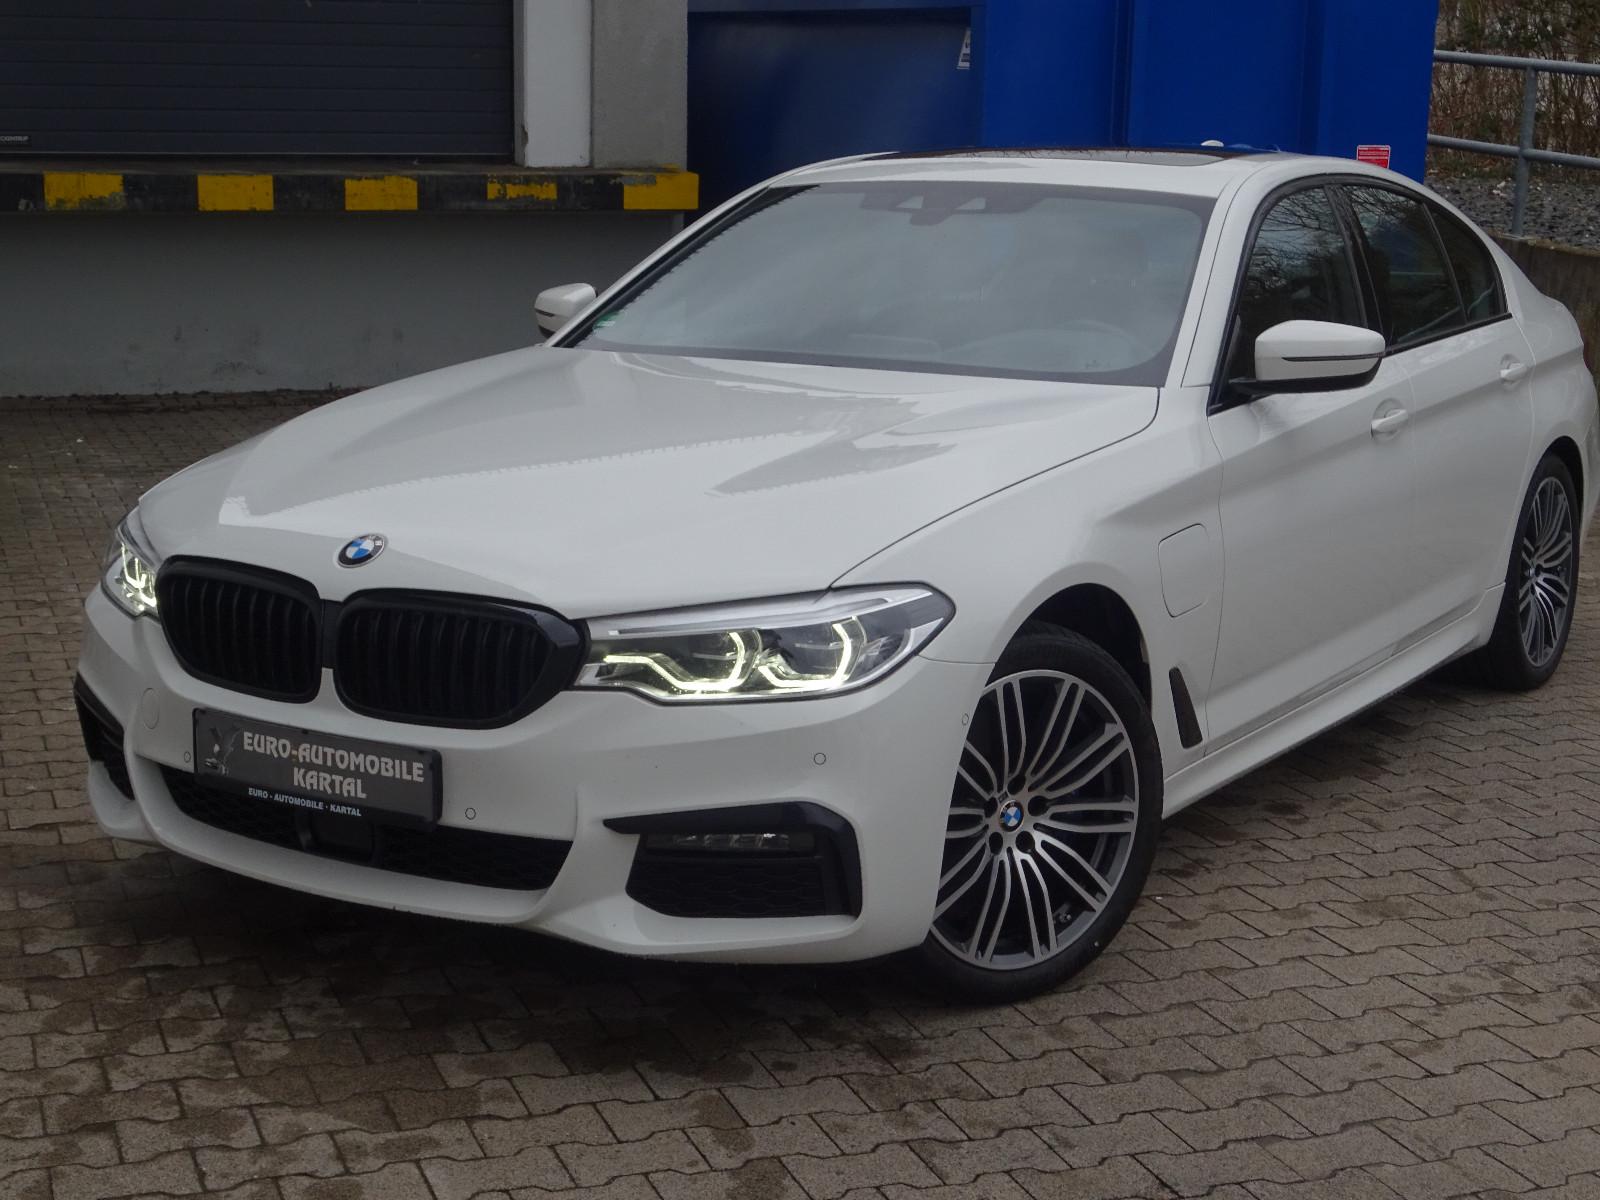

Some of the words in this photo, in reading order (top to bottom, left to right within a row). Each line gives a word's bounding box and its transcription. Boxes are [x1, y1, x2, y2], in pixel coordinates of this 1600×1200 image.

[243, 731, 425, 783] EURO-AUTOMOBILE
[293, 766, 368, 799] KARTAL
[247, 787, 269, 800] EURO
[273, 793, 324, 810] AUTOMOBILE
[329, 804, 362, 817] KARTAL
